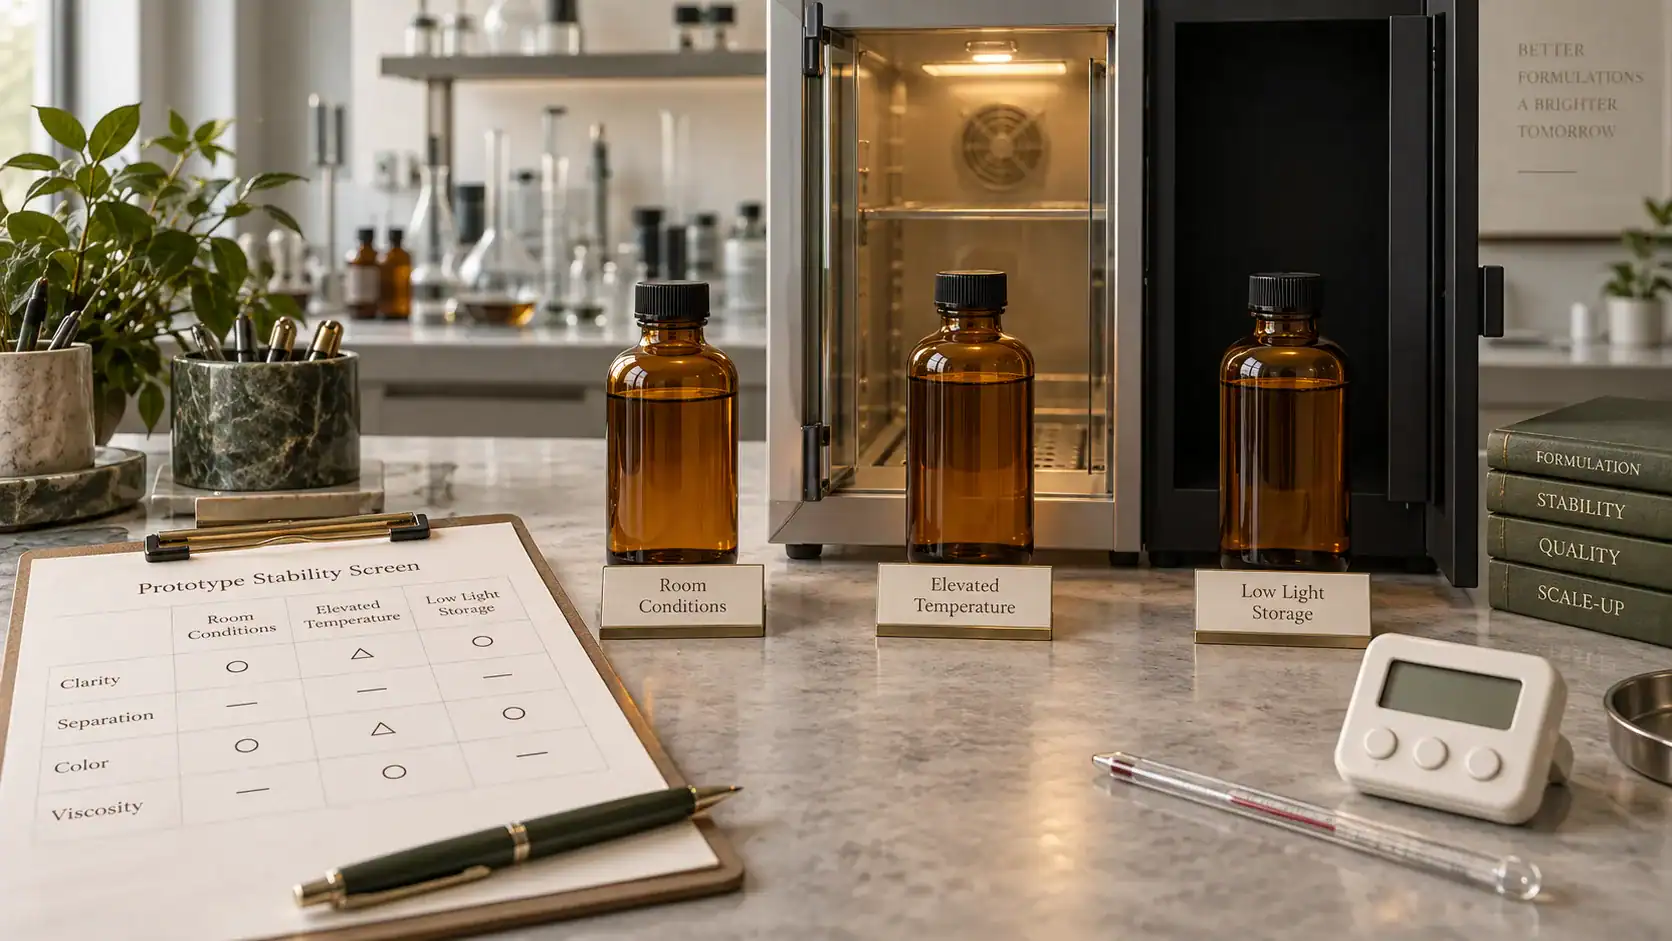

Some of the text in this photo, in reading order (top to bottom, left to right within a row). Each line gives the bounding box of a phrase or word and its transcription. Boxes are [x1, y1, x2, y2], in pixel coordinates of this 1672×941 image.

[1518, 43, 1585, 57] BETTER
[1518, 71, 1645, 85] FORMULATIONS
[1517, 98, 1618, 112] A BRIGHTER
[1517, 125, 1616, 139] TOMORROW
[1536, 451, 1642, 476] FORMULATION
[1537, 492, 1626, 520] STABILITY
[1539, 538, 1621, 566] QUALITY
[138, 563, 421, 595] Prototype Stability Screen
[659, 578, 707, 592] Room
[931, 577, 1000, 593] Elevated
[425, 590, 500, 605] Low Light
[1241, 584, 1325, 604] Low Light
[1537, 585, 1625, 616] SCALE-UP
[316, 600, 381, 616] Elevated
[438, 602, 495, 616] Storage
[639, 598, 727, 614] Conditions
[913, 598, 1016, 617] Temperature
[207, 614, 254, 625] Room
[304, 612, 401, 629] Temperature
[1252, 605, 1313, 625] Storage
[187, 623, 277, 640] Conditions
[60, 675, 121, 689] Clarity
[57, 712, 154, 730] Separation
[54, 758, 109, 774] Color
[51, 801, 144, 821] Viscosity
